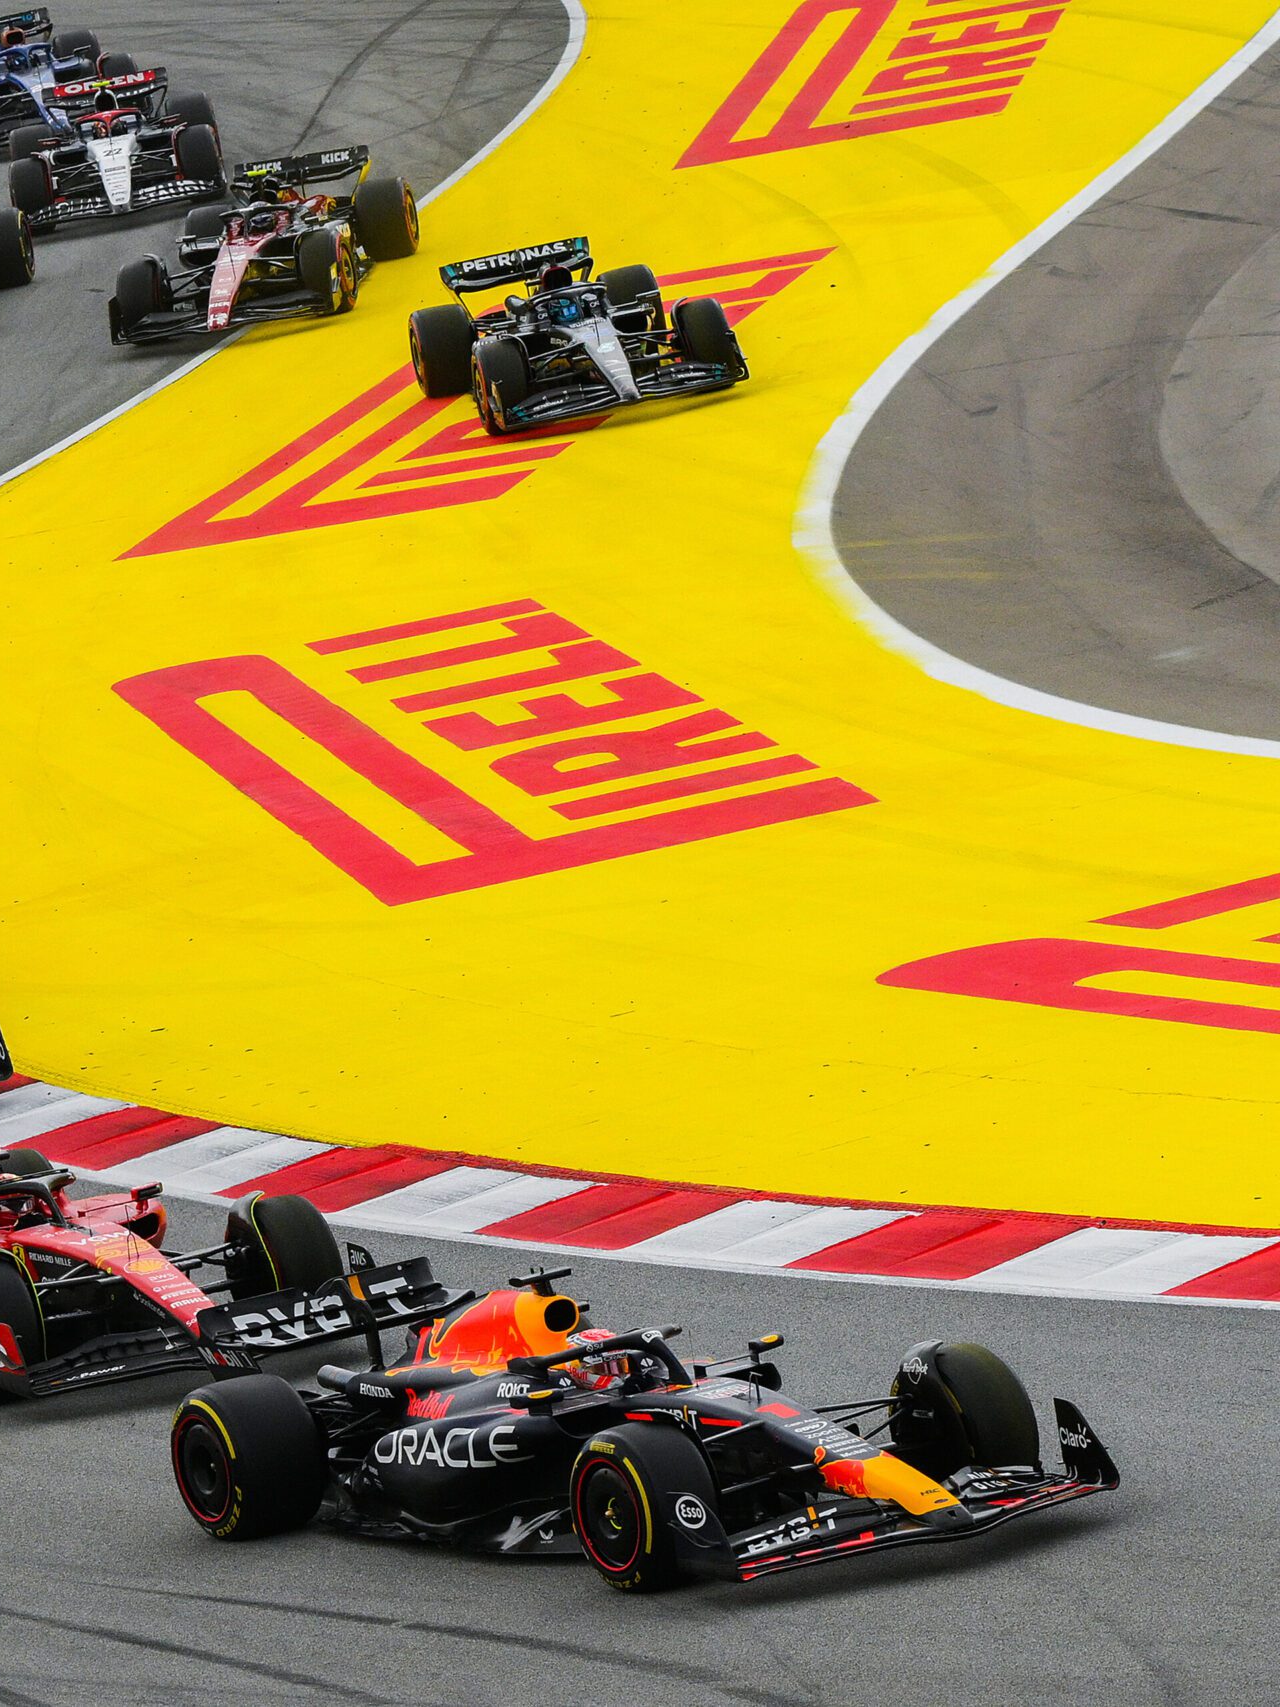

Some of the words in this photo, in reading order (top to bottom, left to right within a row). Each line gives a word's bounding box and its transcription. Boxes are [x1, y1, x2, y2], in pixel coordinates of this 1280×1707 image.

[103, 148, 122, 158] 22
[320, 151, 350, 164] KICK
[463, 241, 568, 274] PETRONAS
[28, 1251, 54, 1265] RICHARD
[54, 1255, 73, 1267] MILLE
[350, 1250, 367, 1266] aws
[203, 1347, 244, 1368] Mobil
[240, 1352, 254, 1367] 1
[359, 1382, 394, 1399] HONDA
[374, 1425, 536, 1468] ORACLE
[1059, 1428, 1088, 1450] Claro
[234, 1485, 243, 1502] P
[216, 1503, 241, 1537] ZERO
